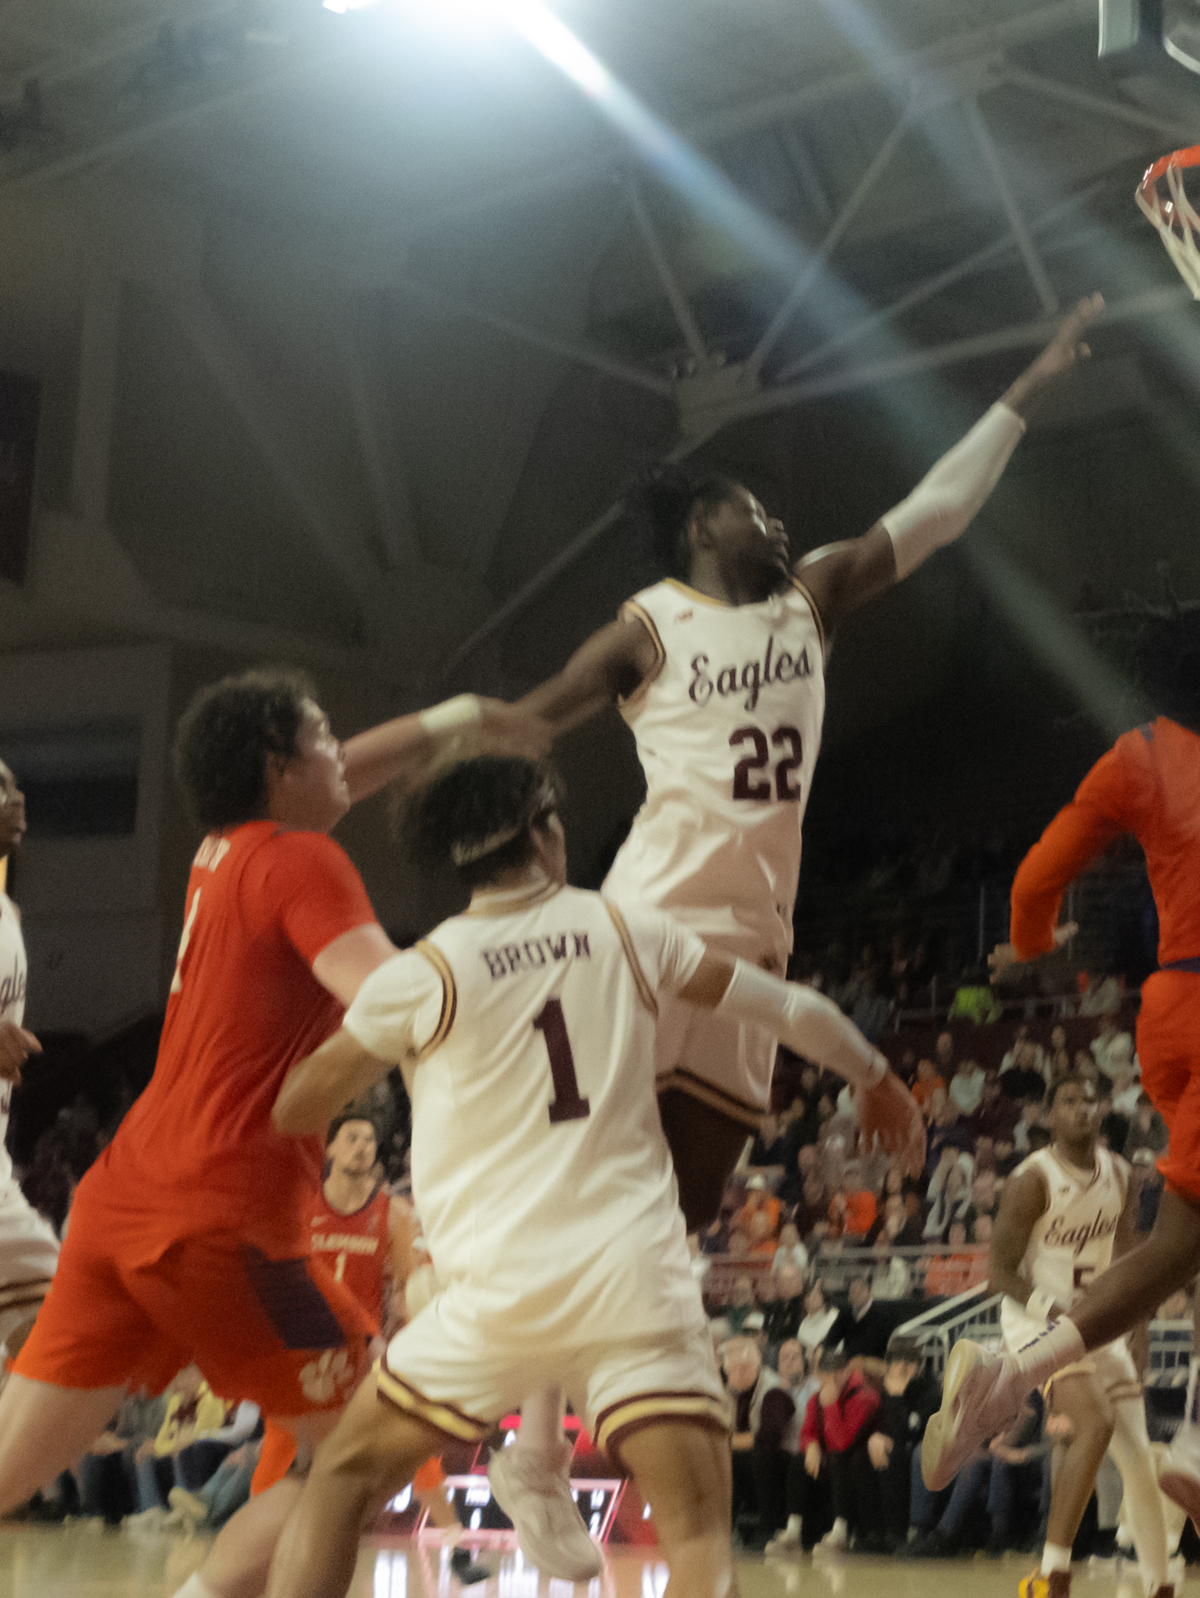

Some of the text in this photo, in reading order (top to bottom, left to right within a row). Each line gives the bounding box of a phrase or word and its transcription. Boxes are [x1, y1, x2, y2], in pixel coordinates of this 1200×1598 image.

[688, 633, 813, 713] Eagles
[729, 725, 803, 802] 22
[481, 929, 591, 981] BROWN
[532, 996, 591, 1124] 1
